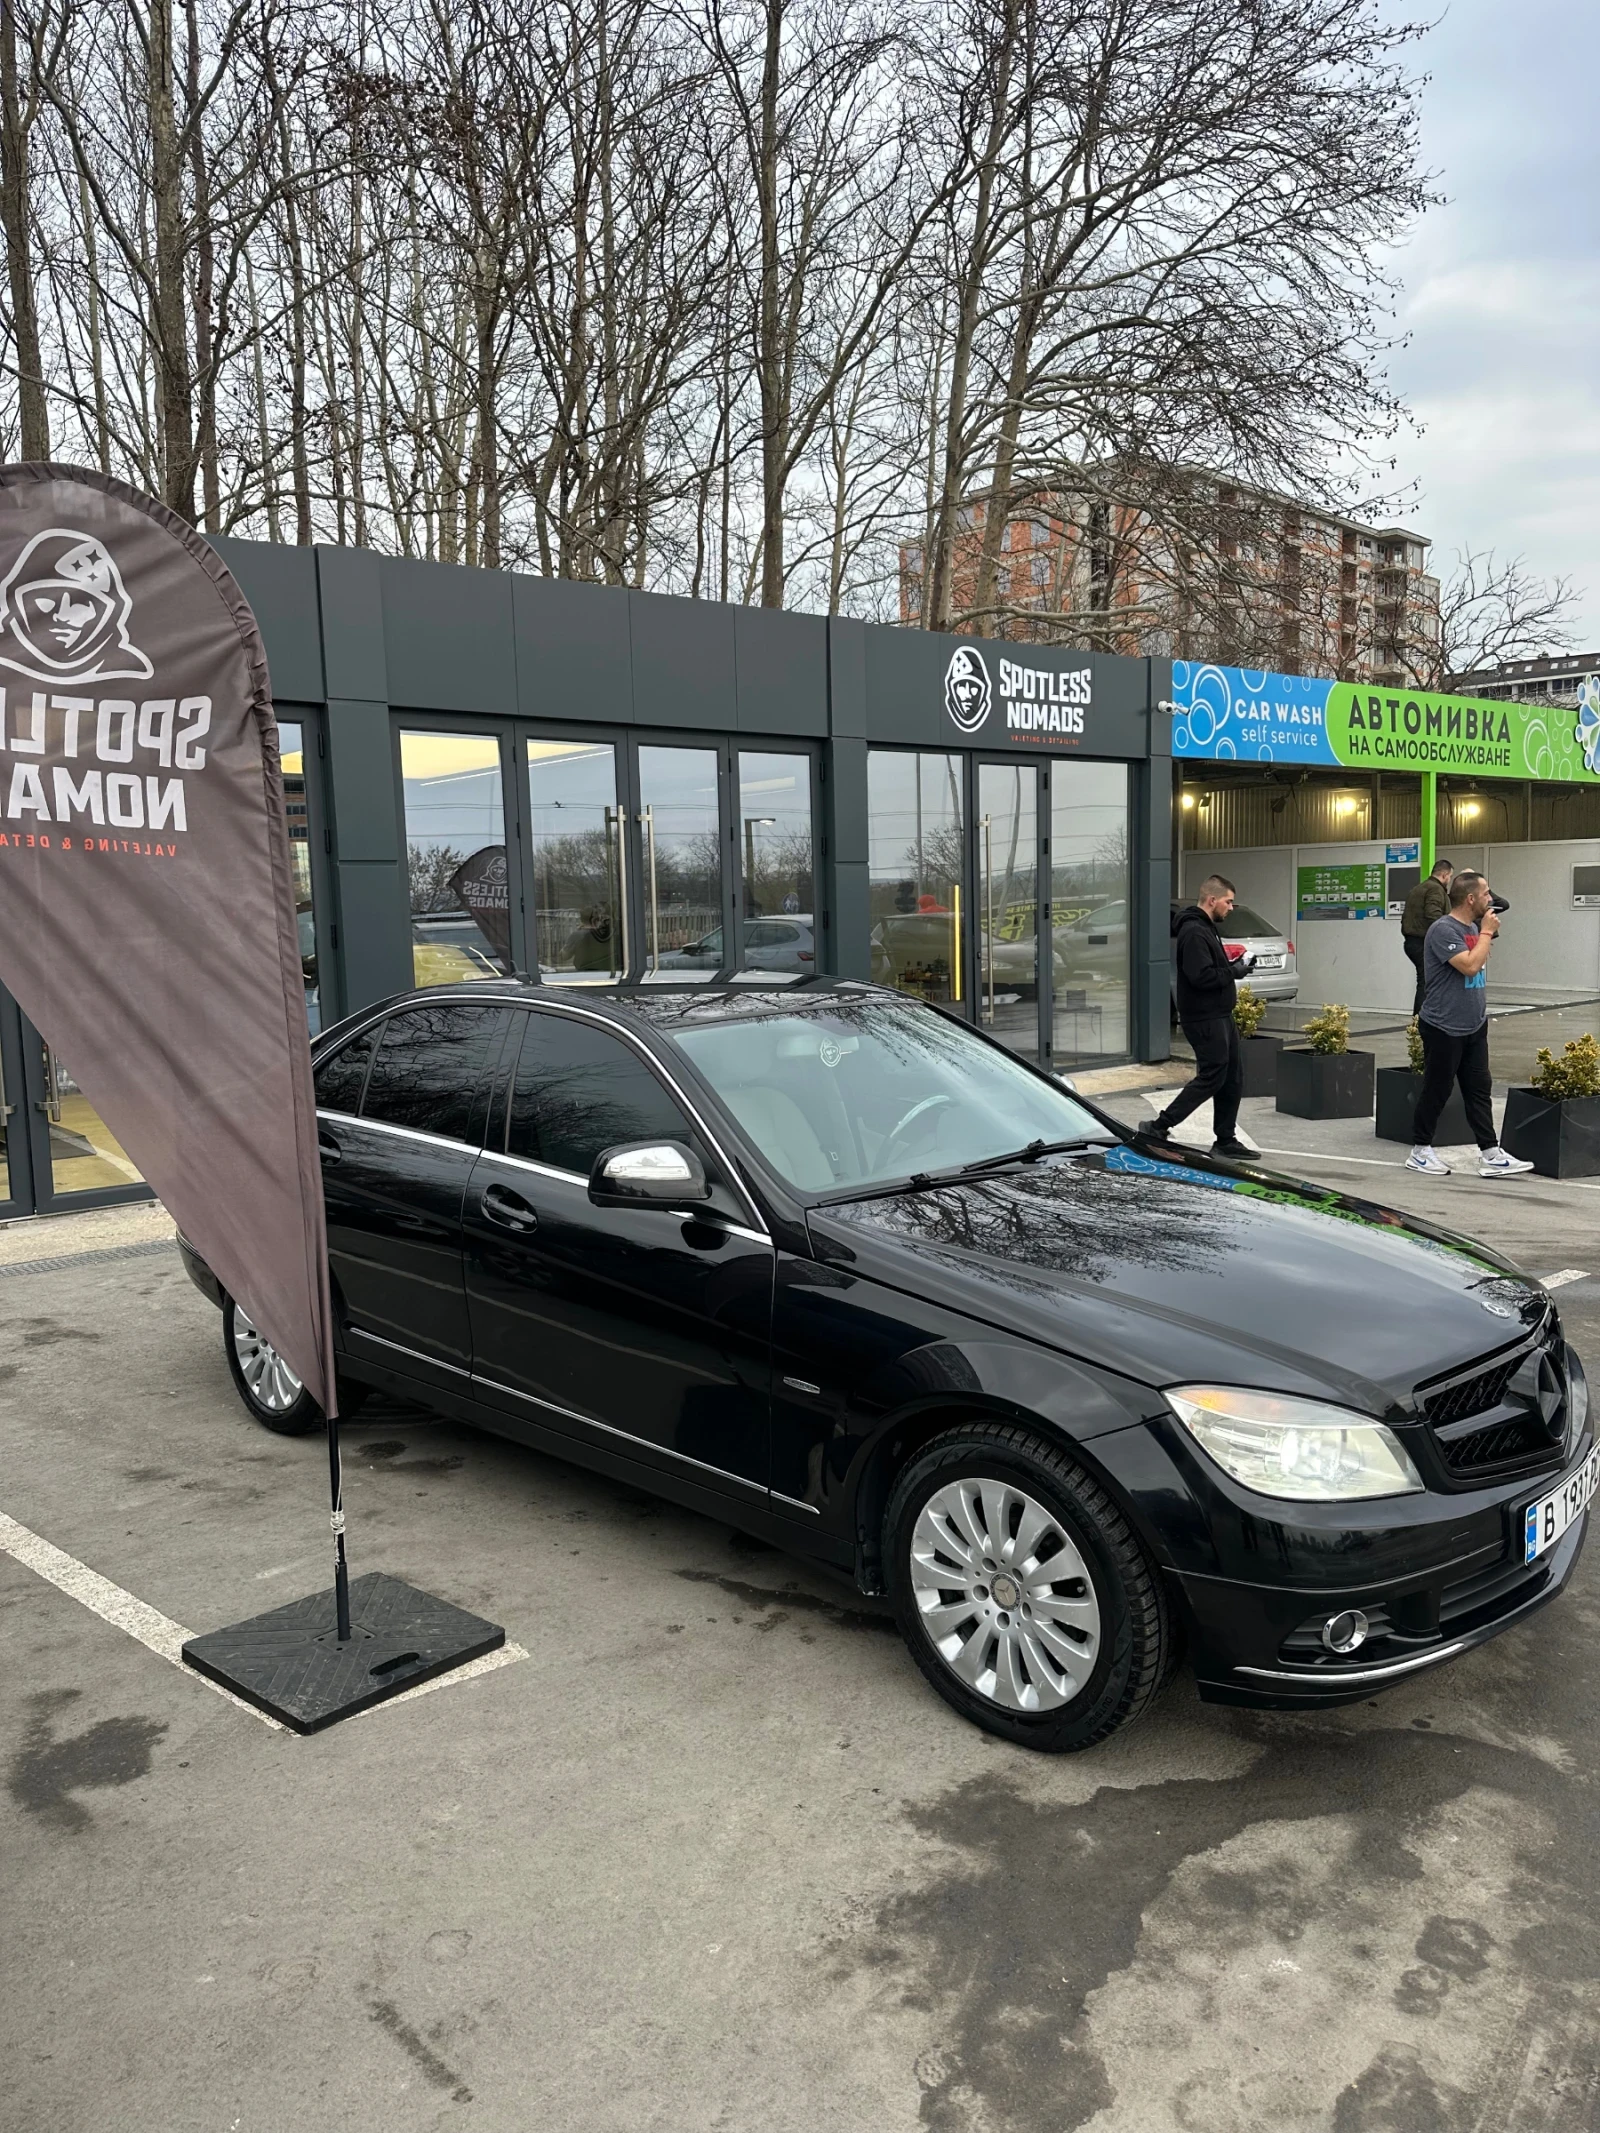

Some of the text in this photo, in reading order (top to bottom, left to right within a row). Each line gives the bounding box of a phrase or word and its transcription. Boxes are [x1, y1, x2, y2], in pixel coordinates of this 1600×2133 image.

[999, 657, 1092, 705] SPOTLESS
[1006, 700, 1084, 734] NOMADS
[1234, 698, 1322, 726] CAR WASH
[1348, 694, 1511, 743] АВТОМИВКА
[1241, 723, 1318, 746] self service
[1348, 735, 1511, 767] НА САМООБСЛУЖВАНЕ
[1543, 1501, 1555, 1544] B
